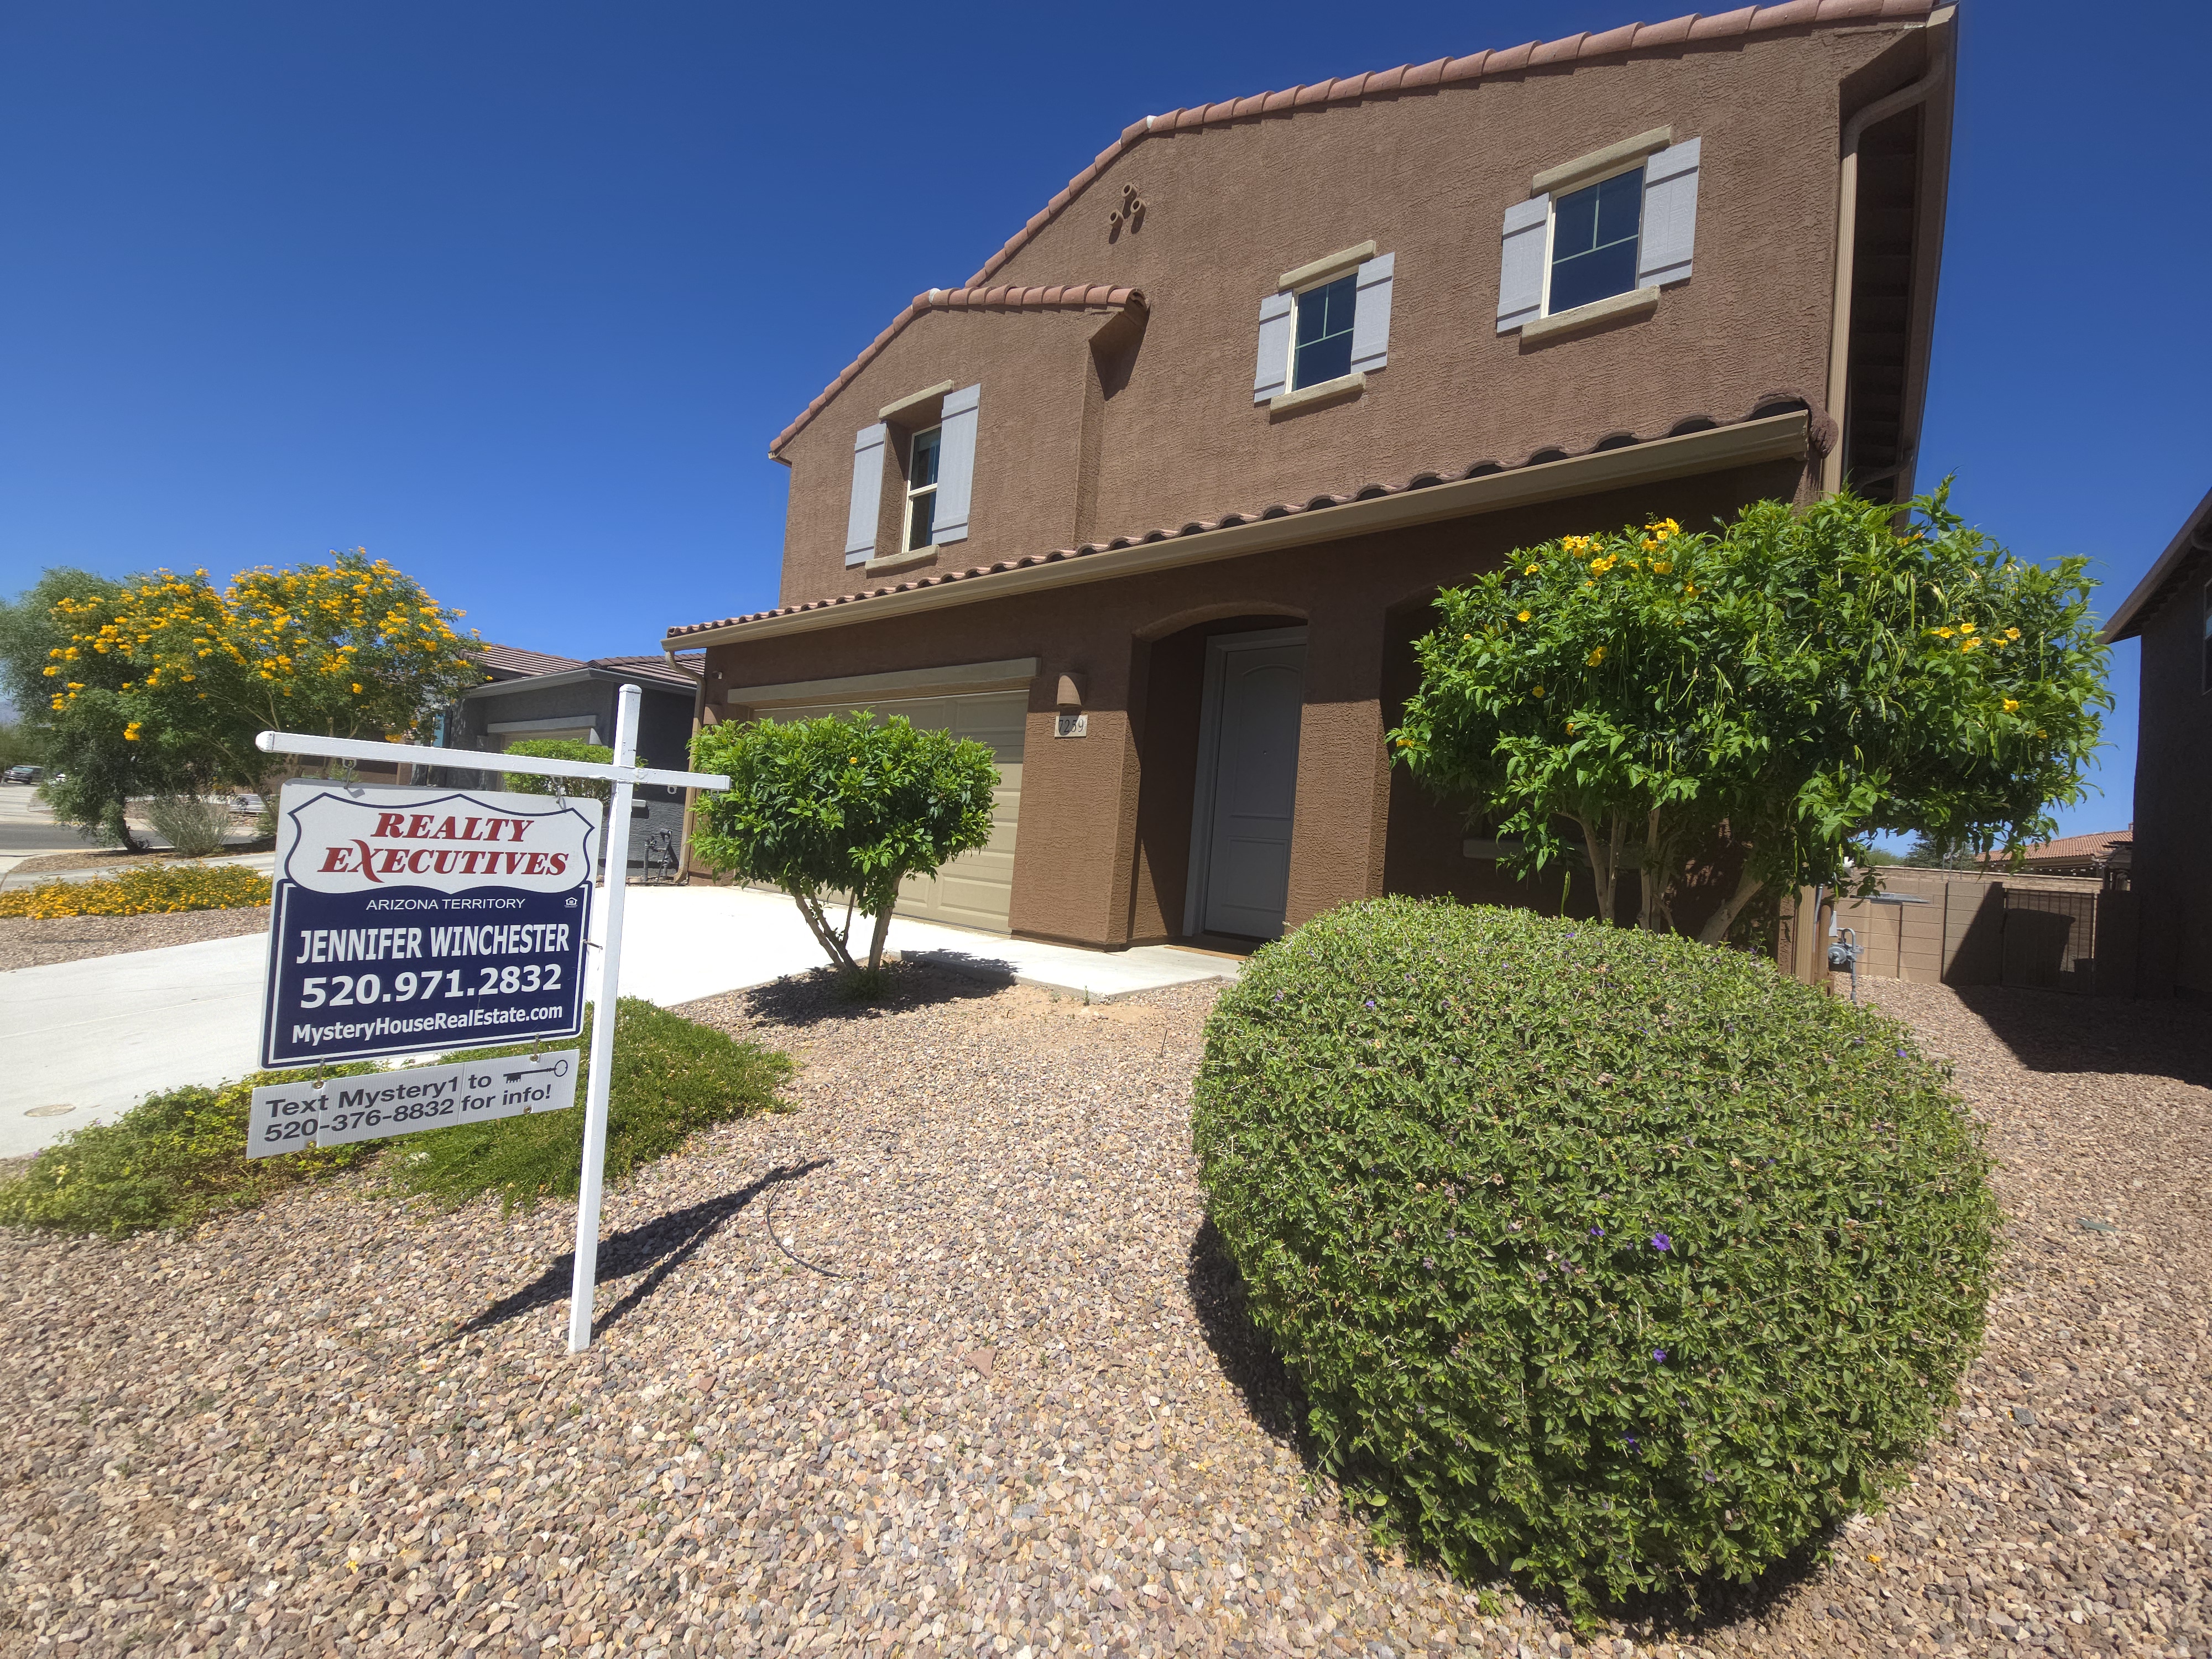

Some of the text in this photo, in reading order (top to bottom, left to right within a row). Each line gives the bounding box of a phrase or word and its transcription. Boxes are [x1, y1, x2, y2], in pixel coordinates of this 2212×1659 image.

[1059, 719, 1084, 733] 7259
[370, 812, 534, 842] REALTY
[317, 839, 569, 883] EXECUTIVES
[366, 898, 526, 911] ARIZONA TERRITORY
[296, 924, 570, 964] JENNIFER WINCHESTER
[300, 964, 562, 1009] 520.971.2832
[292, 1004, 563, 1046] MysteryHouseRealEstate.com
[264, 1084, 552, 1142] 520-376-8832 for info!
[265, 1073, 492, 1118] Text Mystery1 to
